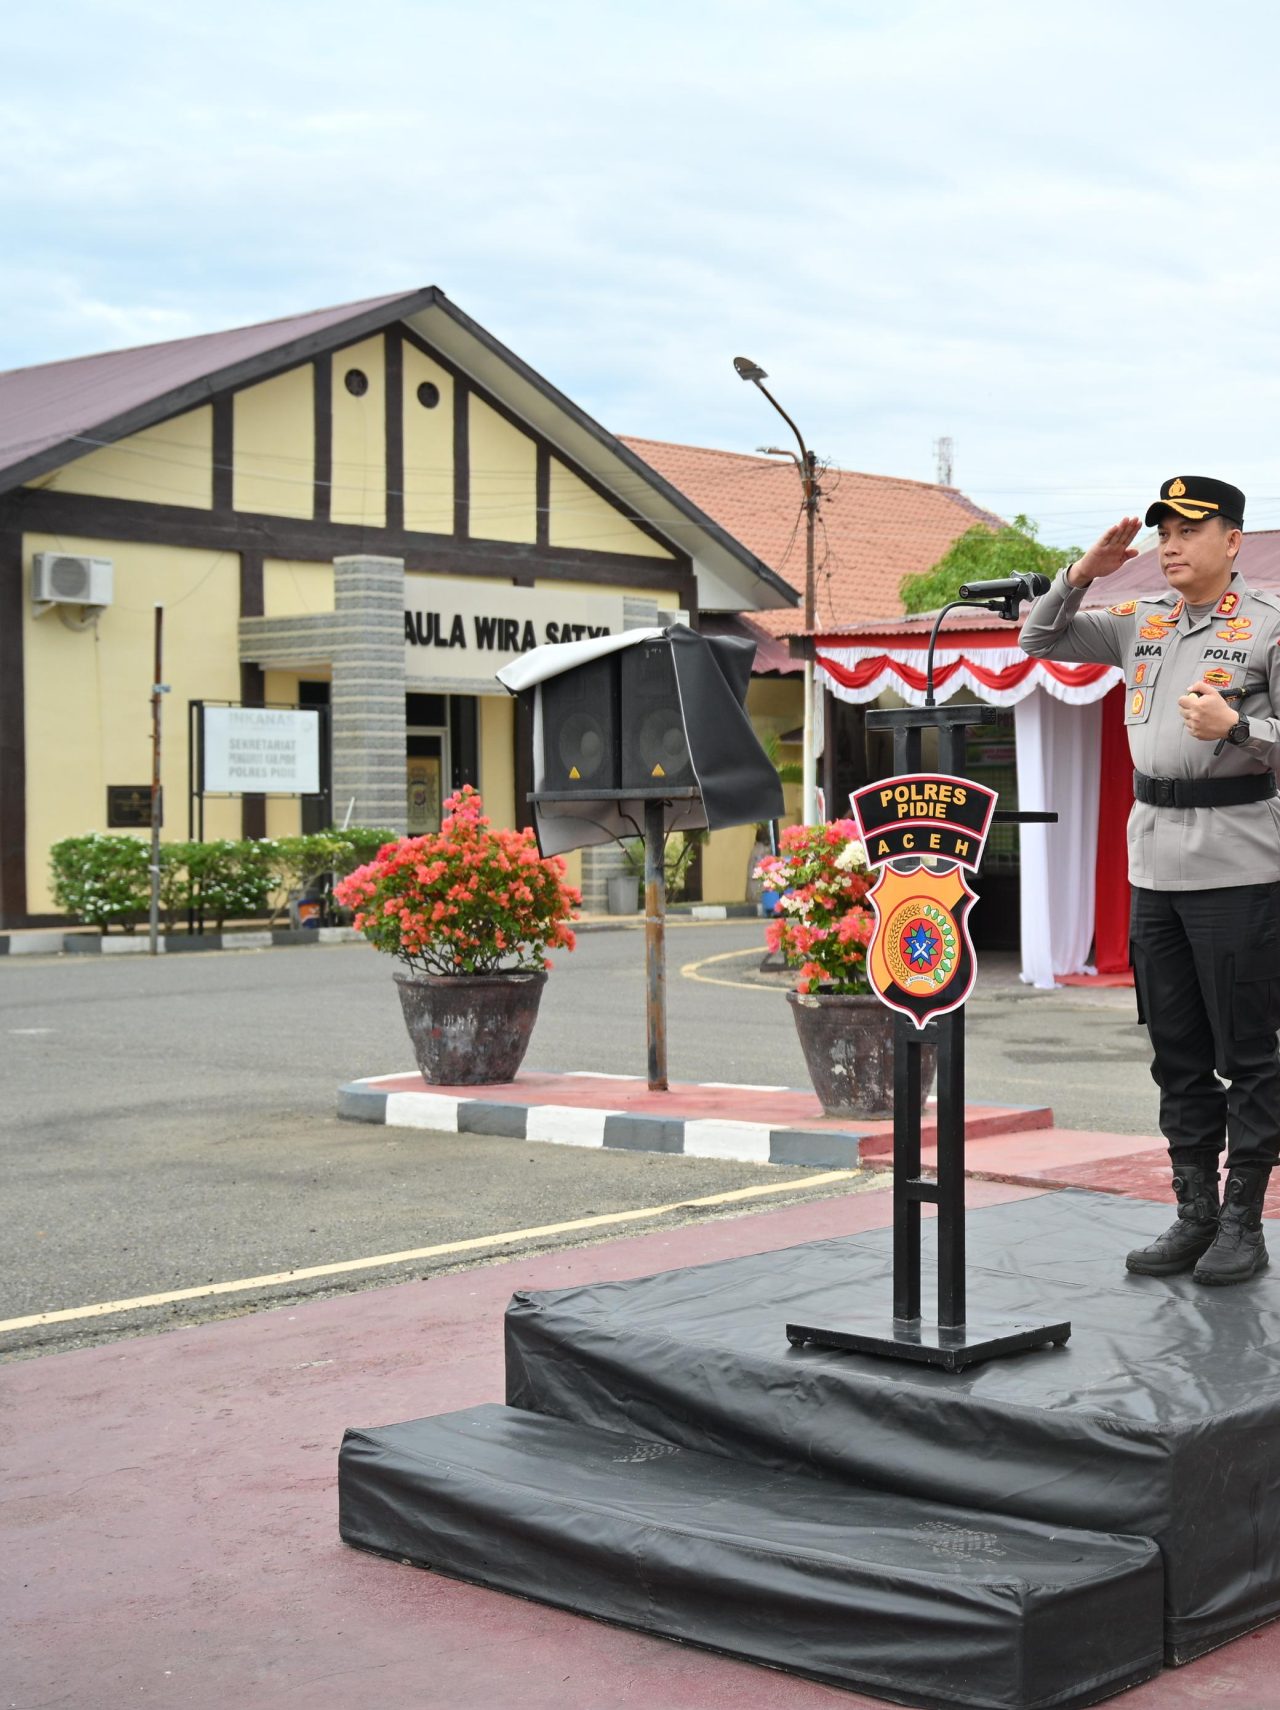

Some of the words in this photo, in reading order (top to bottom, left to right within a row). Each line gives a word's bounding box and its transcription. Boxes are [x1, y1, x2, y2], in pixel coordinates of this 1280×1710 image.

[404, 610, 467, 649] AULA
[474, 616, 538, 652] WIRA
[1134, 645, 1162, 657] JAKA
[1203, 649, 1247, 664] POLRI
[879, 783, 967, 807] POLRES
[897, 802, 947, 819] PIDIE
